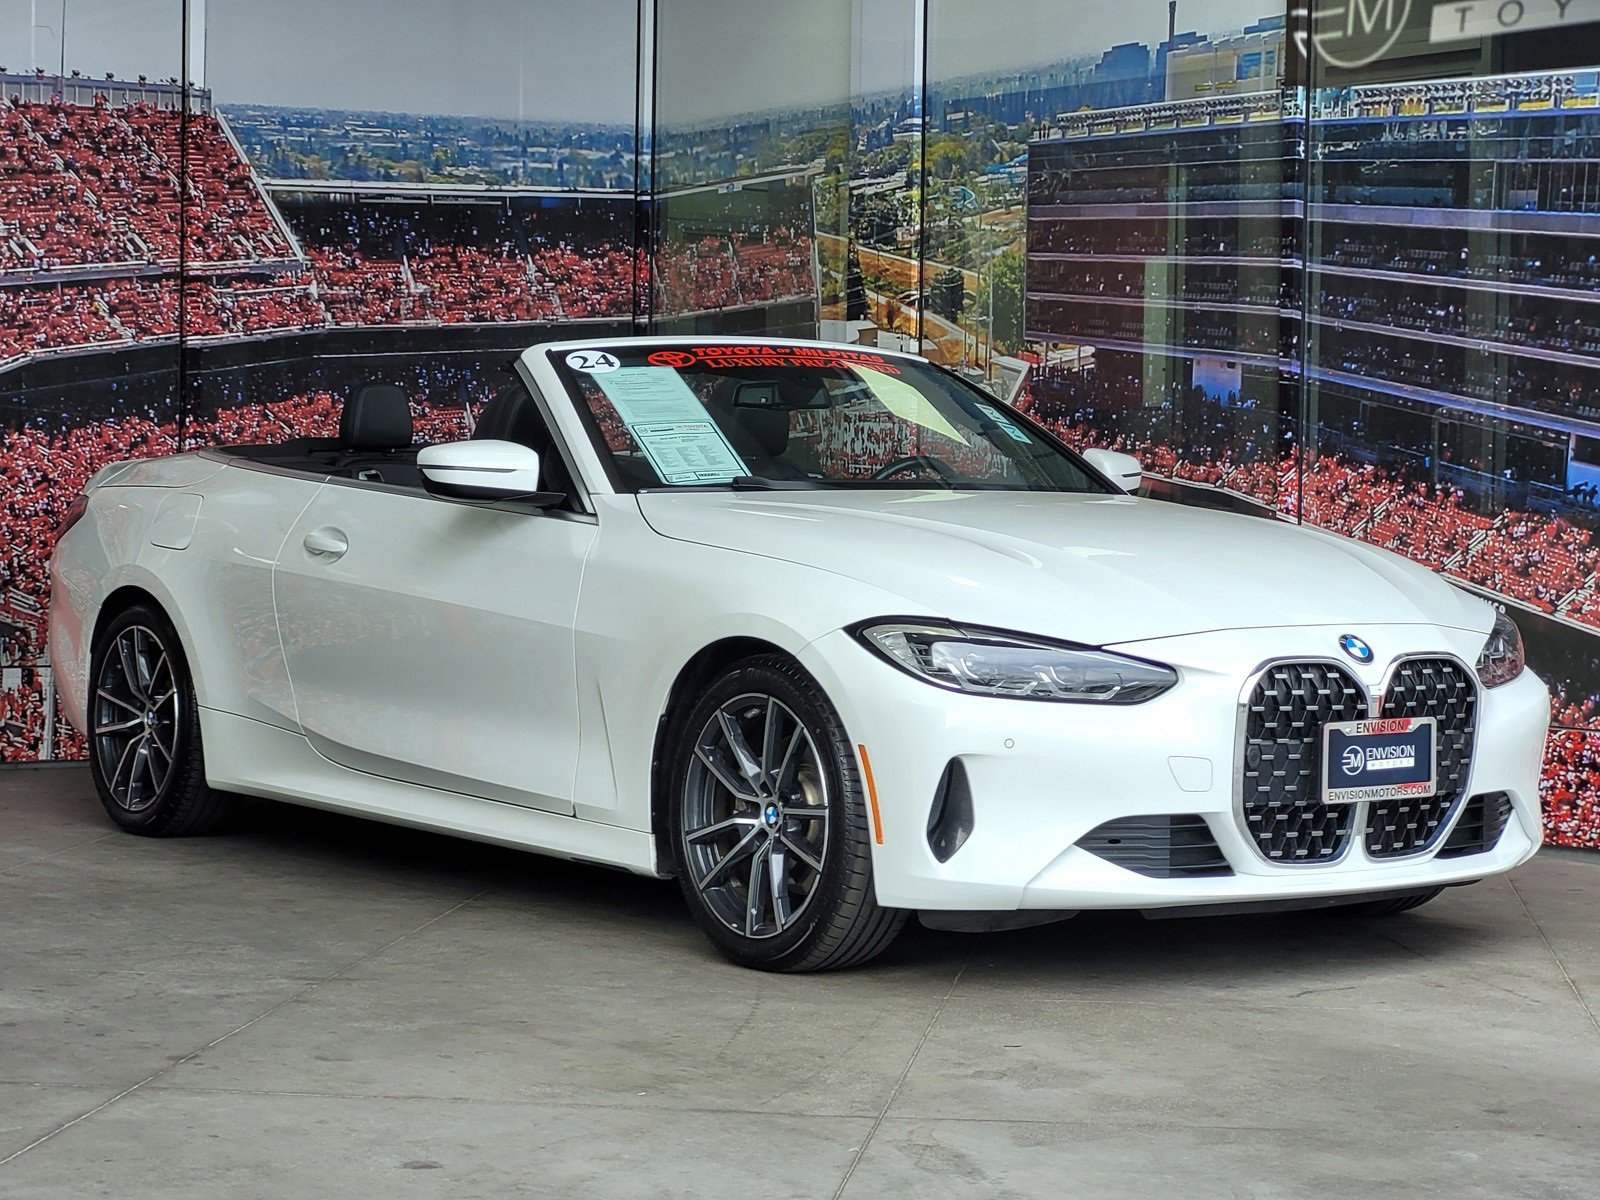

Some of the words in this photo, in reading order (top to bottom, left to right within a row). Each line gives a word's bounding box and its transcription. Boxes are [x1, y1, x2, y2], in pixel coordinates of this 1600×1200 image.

[571, 354, 616, 369] 24
[691, 347, 777, 356] TOYOTA
[793, 347, 885, 363] MILPITAS
[705, 358, 788, 368] LUXURY
[1356, 719, 1405, 734] ENVISION
[1366, 744, 1415, 761] ENVISION
[1328, 784, 1431, 801] ENVISIONMOTORS.COM
